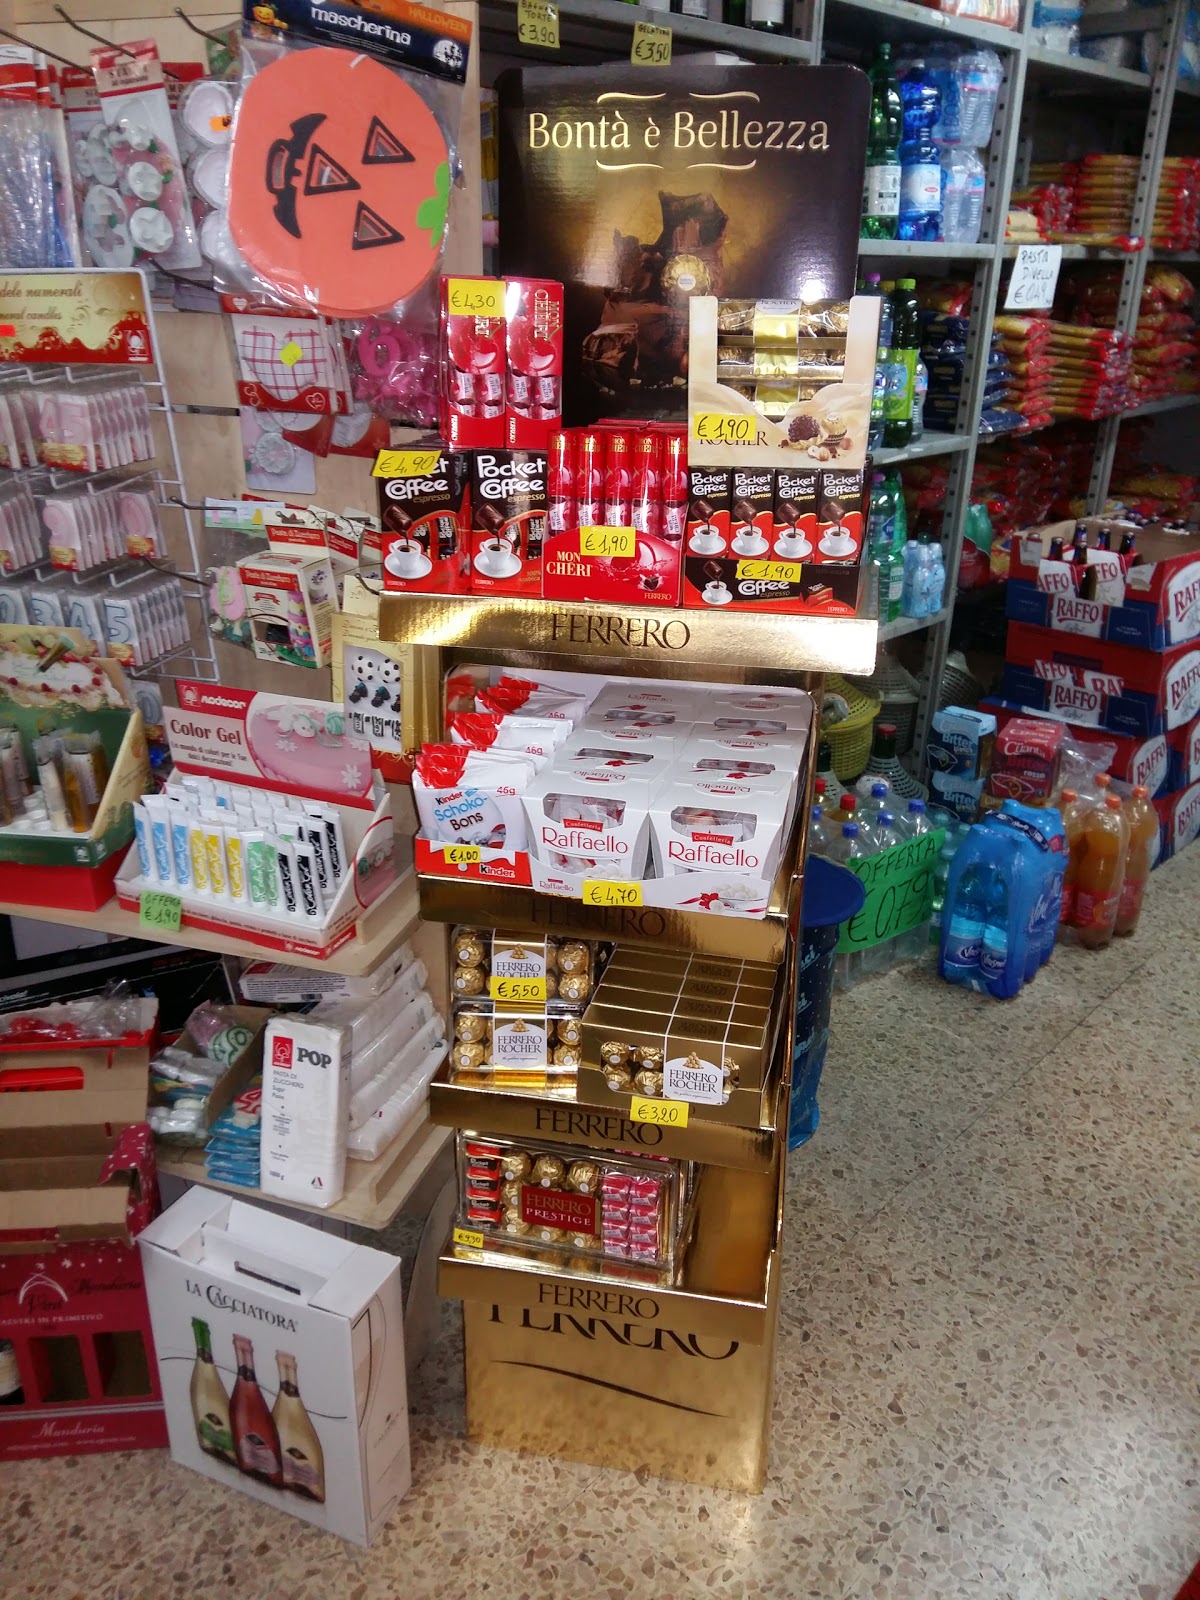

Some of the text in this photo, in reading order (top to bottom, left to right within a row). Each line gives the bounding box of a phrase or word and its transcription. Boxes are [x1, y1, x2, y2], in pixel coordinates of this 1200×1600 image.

[409, 7, 469, 33] HALLOWEEN
[524, 9, 552, 22] TORTE
[311, 6, 412, 46] mascherina
[529, 110, 830, 150] Bontà è Bellezza
[26, 280, 82, 297] numerali
[477, 455, 546, 478] Pocket
[691, 472, 728, 484] Pocket
[735, 473, 772, 486] Pocket
[778, 475, 816, 488] Pocket
[823, 474, 861, 487] Pocket
[385, 479, 449, 500] Coffee
[480, 479, 544, 499] Coffee
[692, 484, 727, 496] Coffee
[736, 484, 771, 498] Coffee
[779, 487, 815, 499] Coffee
[824, 485, 860, 498] Coffee
[507, 493, 545, 502] espresso
[556, 551, 581, 563] MON
[737, 578, 790, 596] Coffee
[760, 590, 791, 598] espresso
[644, 592, 672, 600] FERRERO
[1056, 597, 1099, 622] RAFFO
[550, 612, 691, 650] FERRERO
[1054, 684, 1098, 709] RAFFO
[170, 719, 242, 746] Color Gel
[942, 733, 973, 748] Bitter
[496, 786, 516, 795] 46g
[944, 791, 977, 807] Bitter
[434, 797, 488, 822] Schoko-
[449, 811, 484, 831] Bons
[542, 826, 628, 855] Raffaello
[669, 841, 759, 868] Raffaello
[539, 881, 574, 892] Raffaello
[496, 961, 541, 972] FERRERO
[497, 1035, 542, 1045] FERRERO
[497, 1044, 542, 1054] ROCHER
[297, 1047, 332, 1068] POP
[669, 1069, 718, 1083] FERRERO
[669, 1078, 718, 1093] ROCHER
[536, 1107, 663, 1146] FERRERO
[526, 1193, 592, 1216] FERRERO
[526, 1207, 592, 1227] PRESTIGE
[185, 1279, 298, 1333] LA CACCIATORA
[538, 1282, 660, 1319] FERRERO
